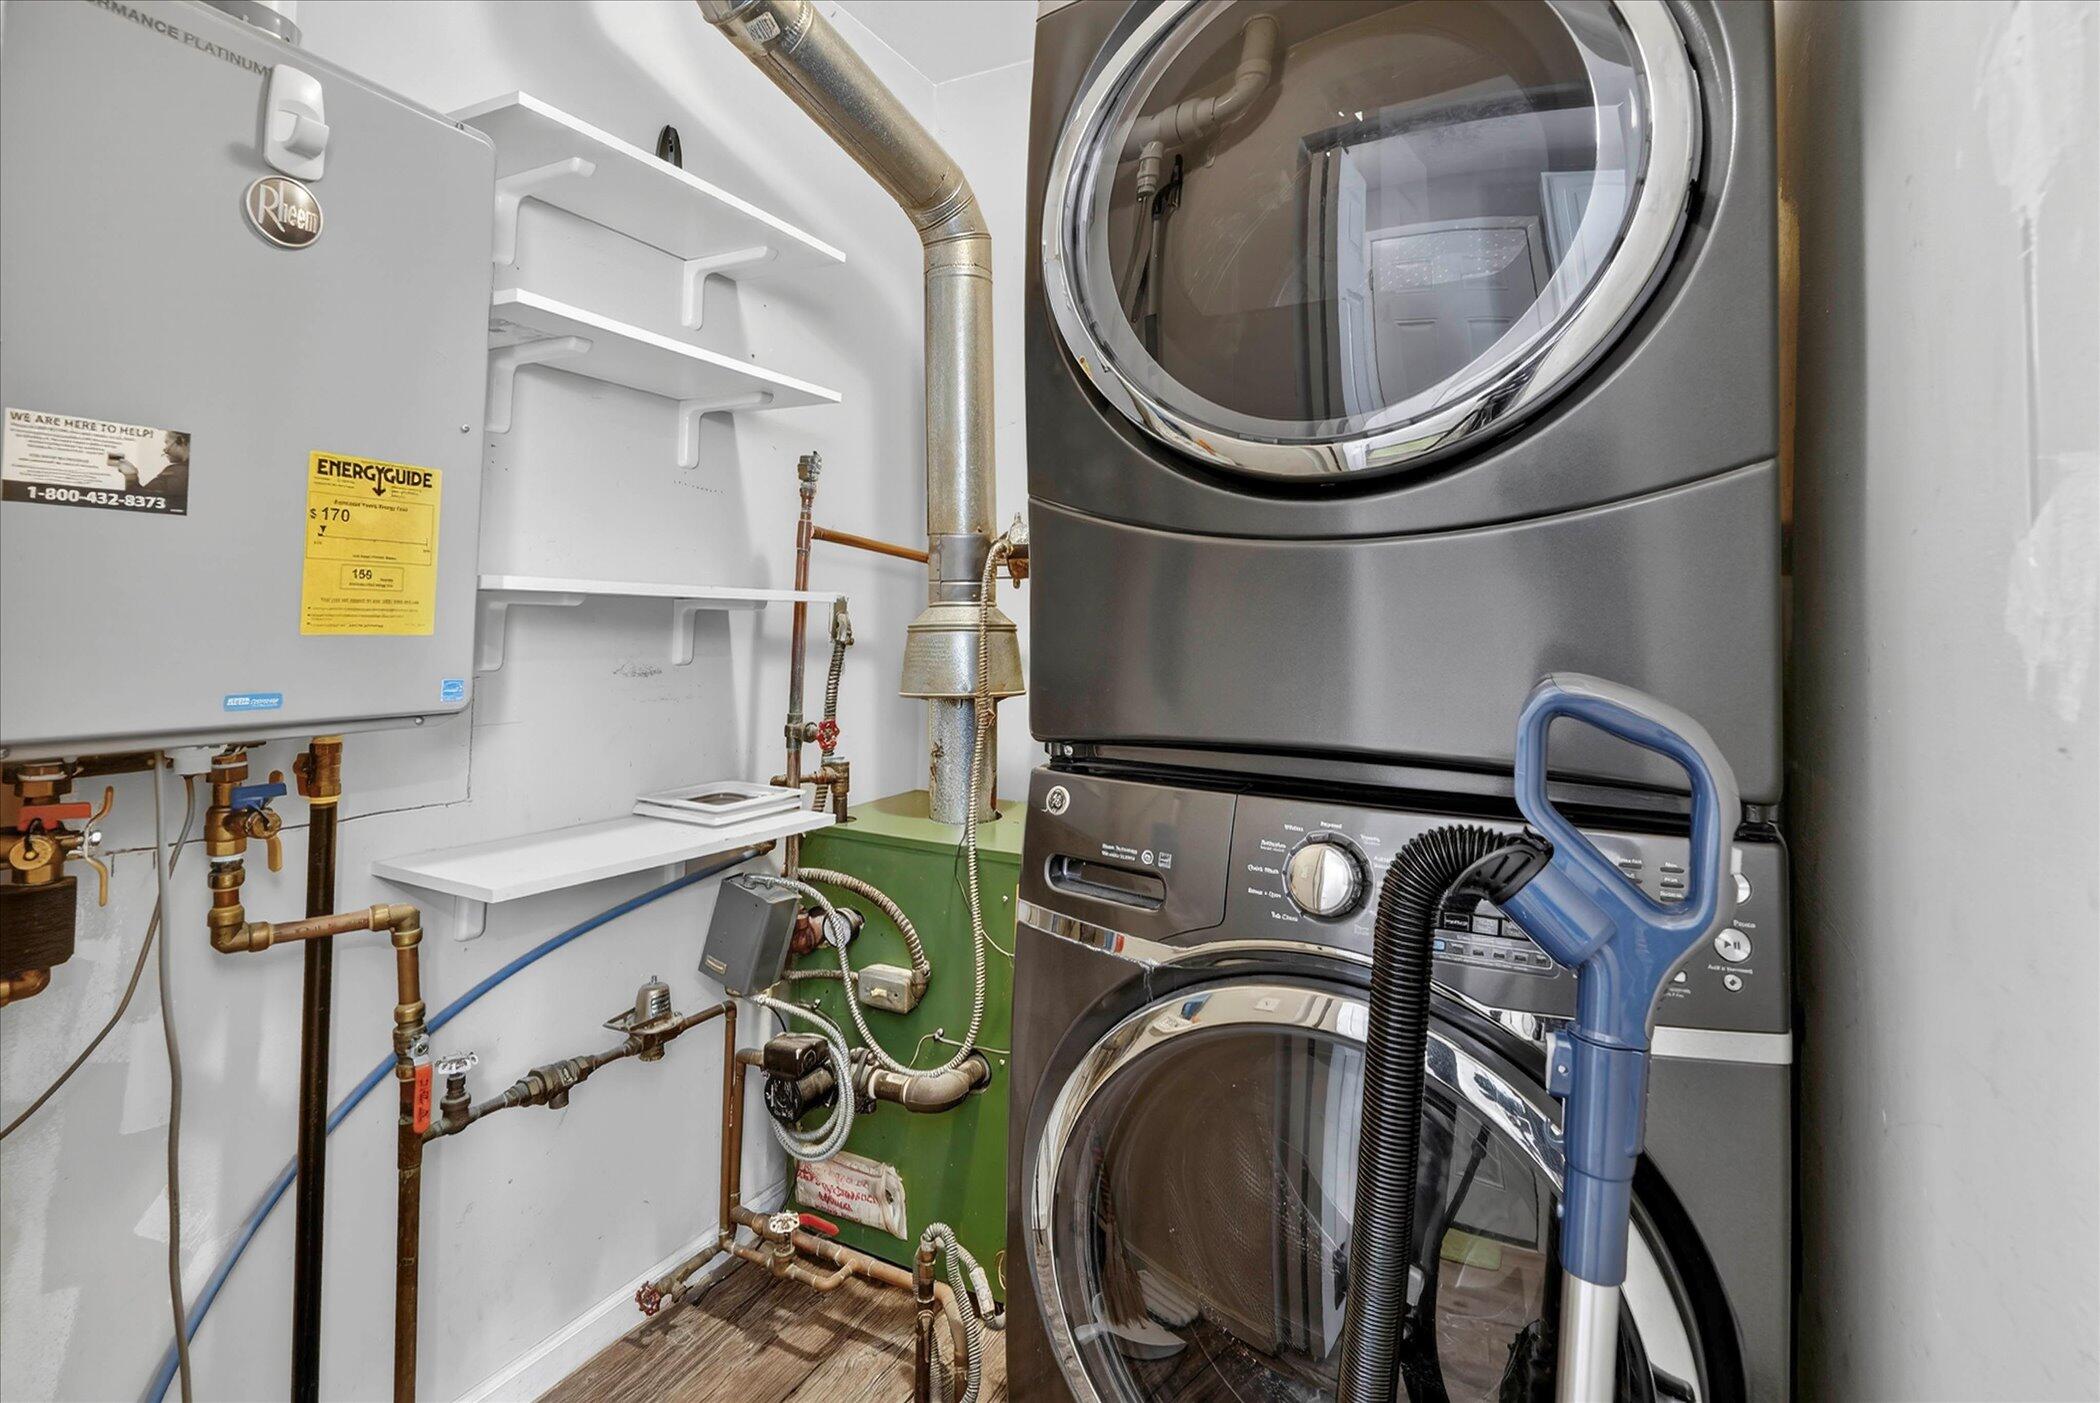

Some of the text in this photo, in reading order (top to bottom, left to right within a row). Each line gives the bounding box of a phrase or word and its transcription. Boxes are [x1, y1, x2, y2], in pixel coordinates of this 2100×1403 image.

[86, 0, 270, 79] RMANCE PLATINUM
[258, 181, 319, 233] Rheem
[10, 411, 154, 439] WE ARE HERE TO HELP!
[317, 458, 433, 489] ENERGYGUIDE
[27, 486, 167, 510] 1-800-432-8373
[310, 506, 350, 523] $ 170
